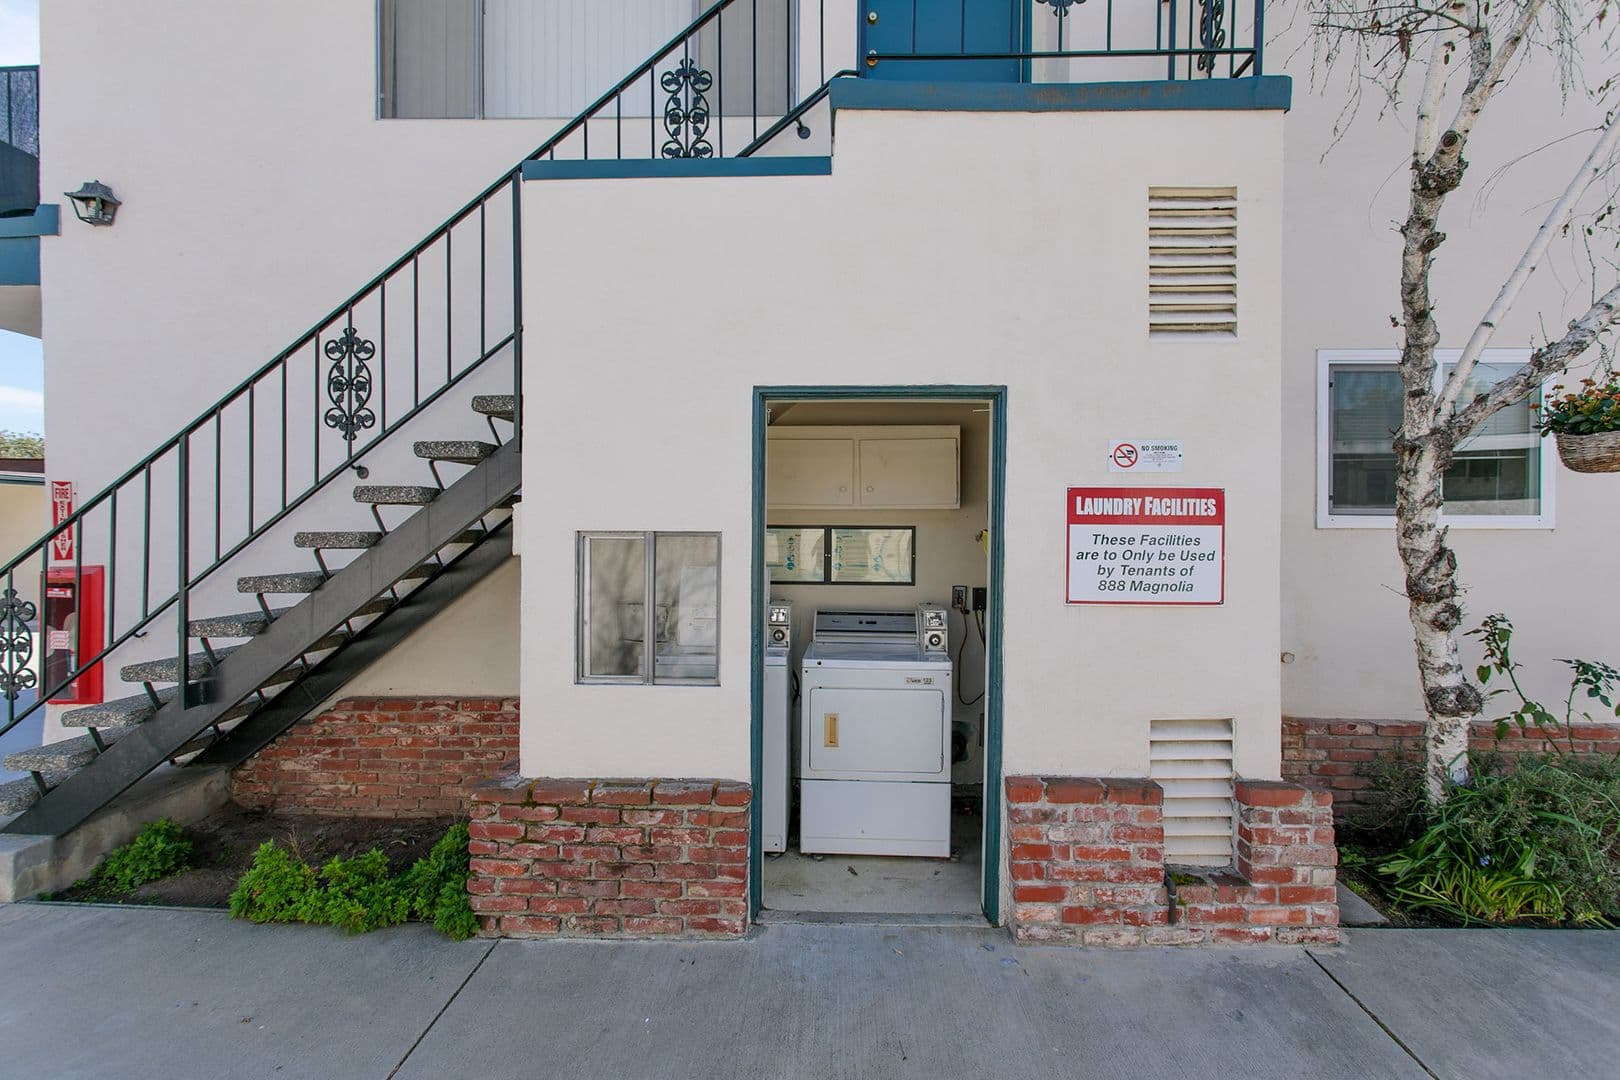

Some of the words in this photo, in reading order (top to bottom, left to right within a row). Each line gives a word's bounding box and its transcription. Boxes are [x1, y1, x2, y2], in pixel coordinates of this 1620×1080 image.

[55, 487, 69, 499] FIRE
[1075, 496, 1142, 516] LAUNDRY
[1144, 496, 1217, 516] FACILITIES
[1092, 534, 1136, 546] These
[1139, 534, 1201, 546] Facilities
[1076, 551, 1099, 561] are
[1104, 550, 1117, 561] to
[1122, 549, 1154, 563] Only
[1158, 550, 1175, 561] be
[1180, 550, 1216, 561] Used
[1097, 565, 1114, 578] by
[1120, 565, 1175, 576] Tenants
[1179, 565, 1195, 576] of
[1098, 580, 1126, 592] 888
[1129, 580, 1194, 594] Magnolia
